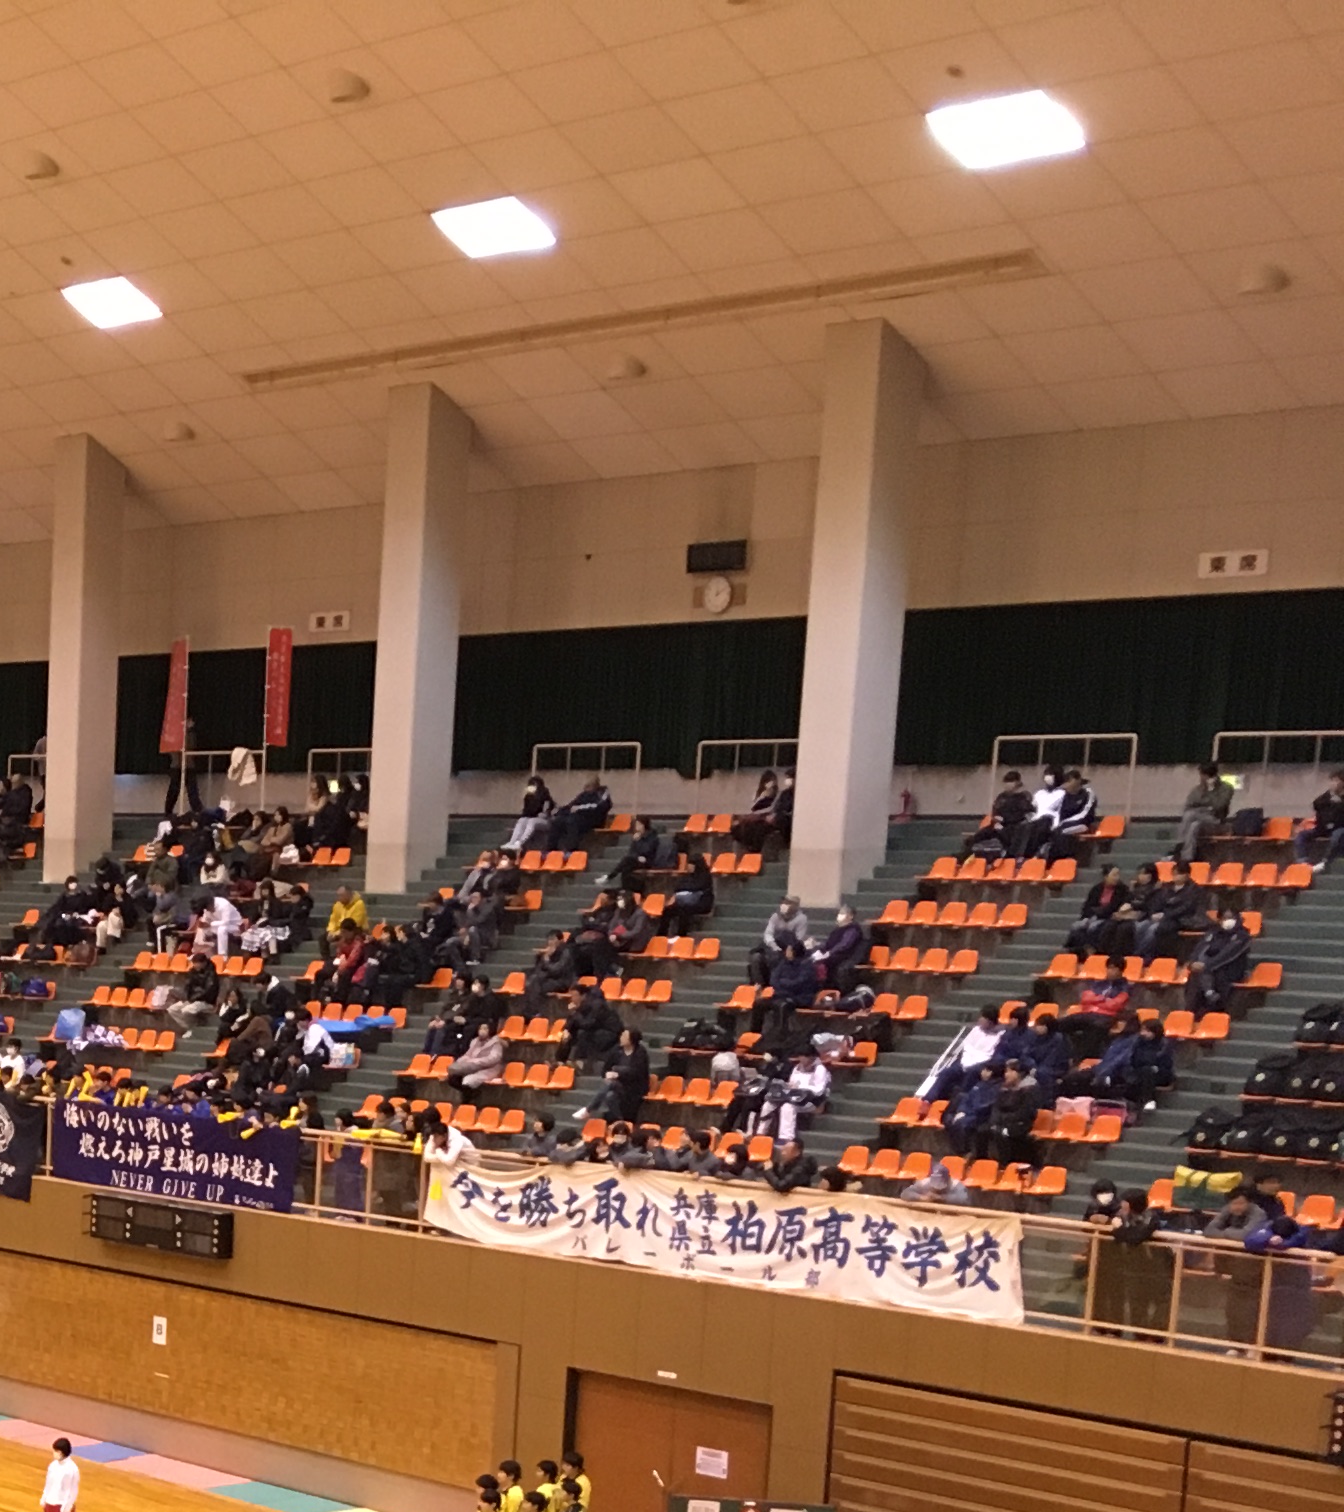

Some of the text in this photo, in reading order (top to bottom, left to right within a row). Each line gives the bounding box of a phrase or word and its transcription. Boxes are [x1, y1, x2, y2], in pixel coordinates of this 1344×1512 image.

[64, 1101, 195, 1147] 悔いのない戦いを
[110, 1168, 154, 1193] NEVER
[162, 1177, 196, 1199] GIVE
[205, 1185, 225, 1203] UP
[450, 1170, 664, 1239] 今を勝ち取れ
[720, 1199, 1002, 1293] 柏原高等学校
